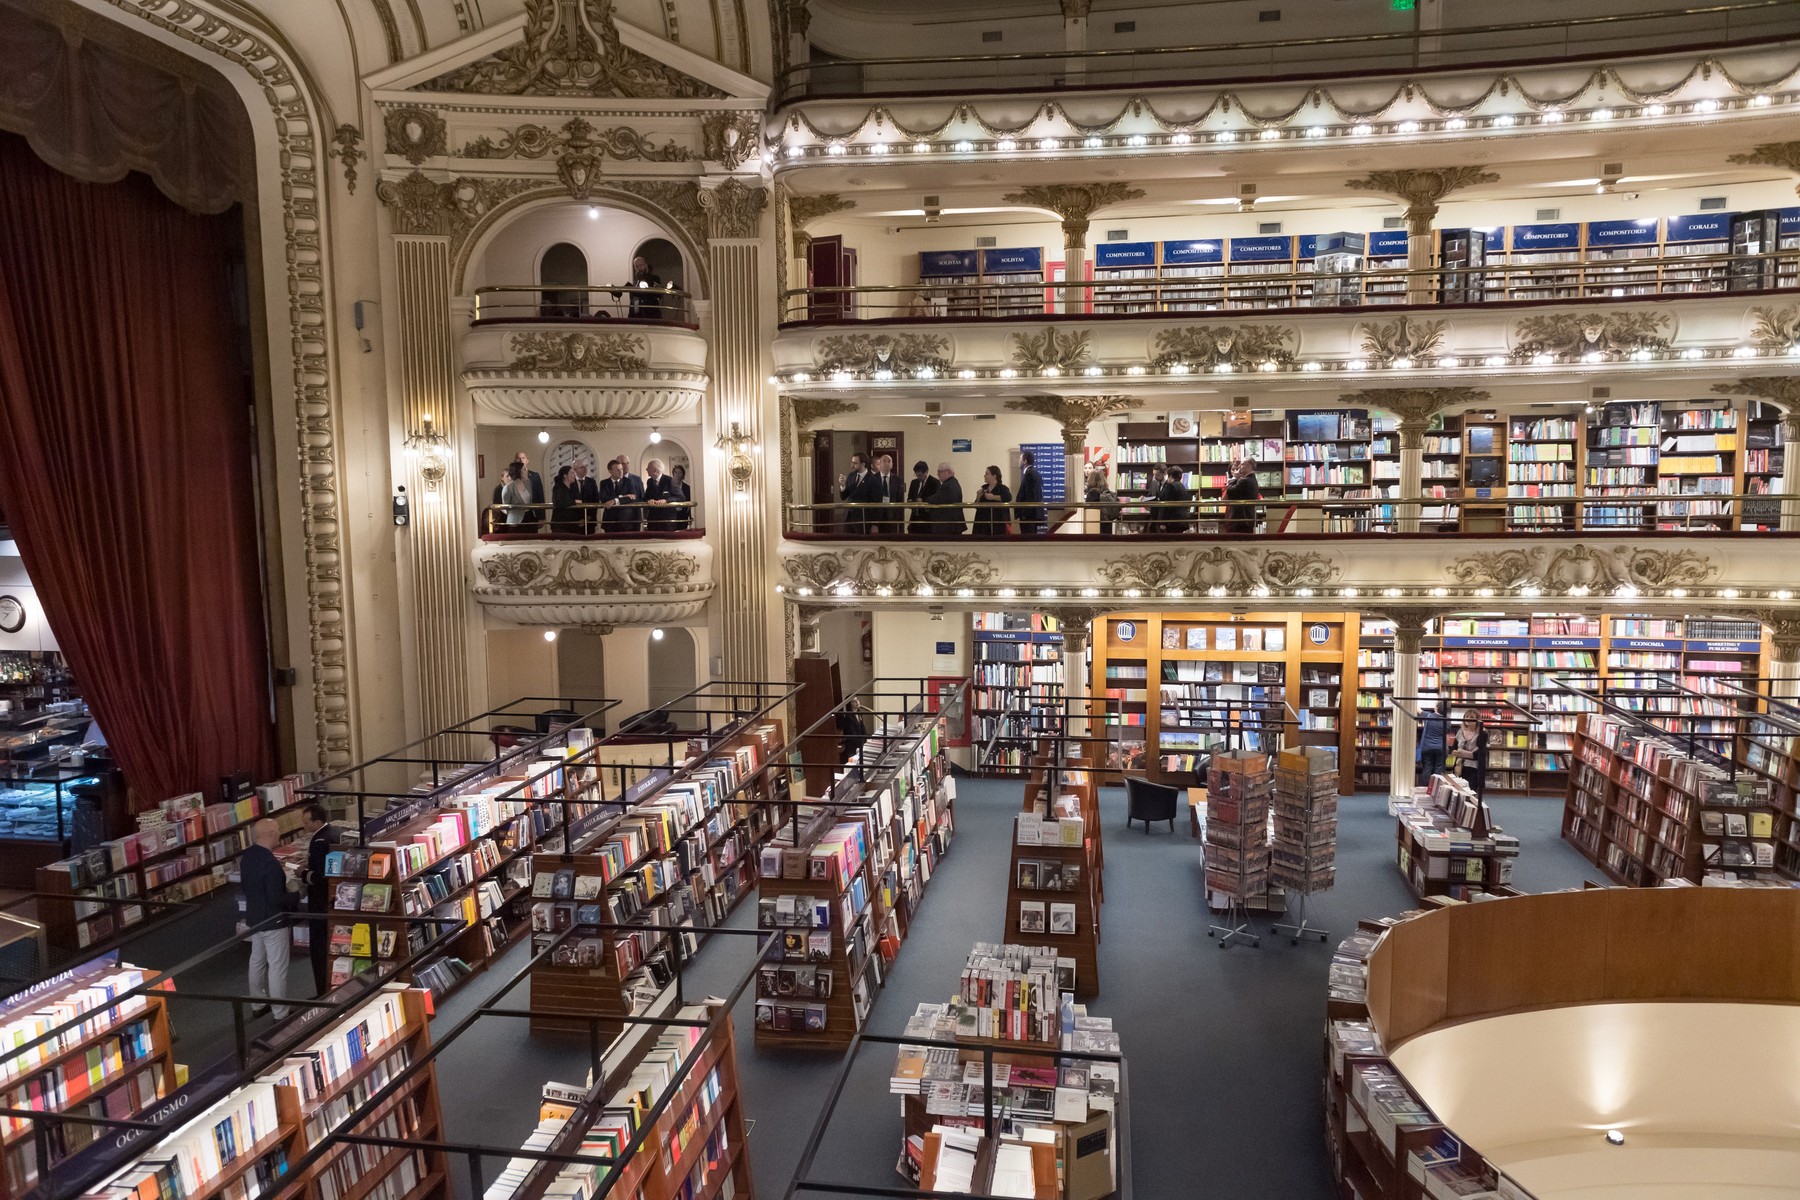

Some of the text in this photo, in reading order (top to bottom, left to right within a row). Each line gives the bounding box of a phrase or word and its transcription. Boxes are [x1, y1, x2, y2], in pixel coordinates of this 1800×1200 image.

[1523, 232, 1569, 240] COMPOSITORES
[1599, 228, 1647, 236] COMPOSITORES
[5, 969, 74, 1006] AUTOAYUDA
[115, 1094, 190, 1150] OCUTISMO
